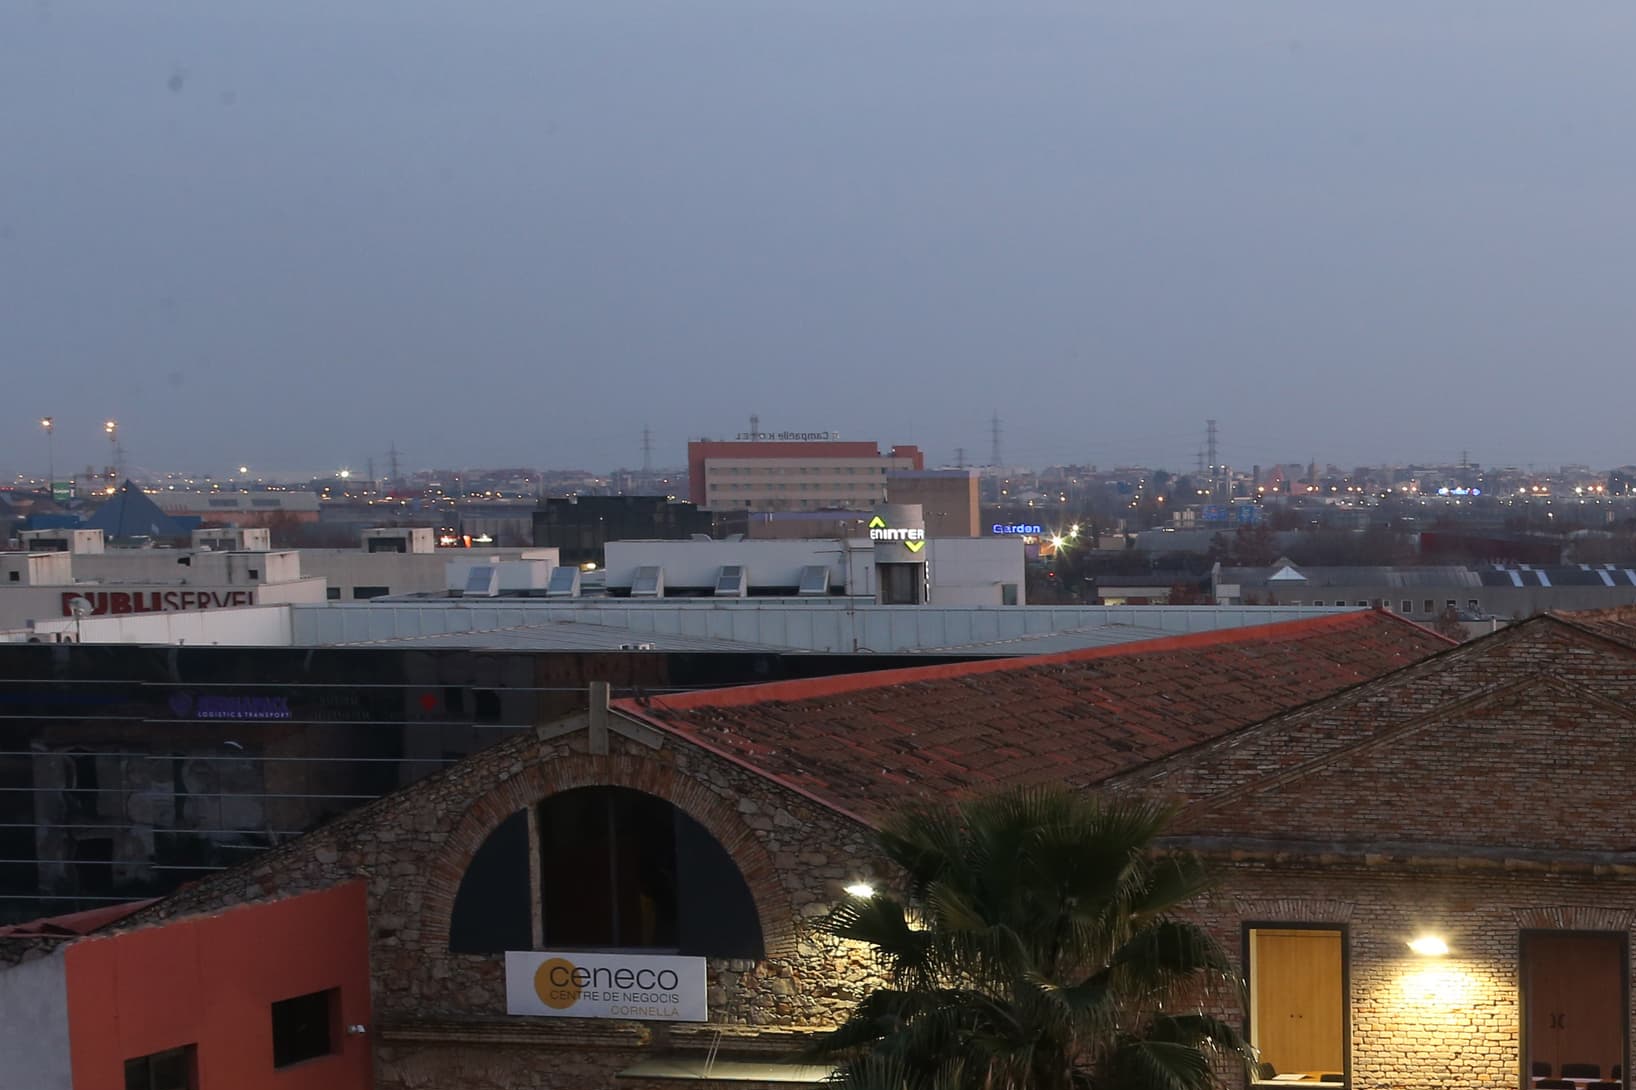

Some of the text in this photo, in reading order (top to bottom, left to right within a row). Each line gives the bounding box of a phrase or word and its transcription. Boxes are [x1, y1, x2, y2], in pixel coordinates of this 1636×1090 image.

[992, 524, 1041, 534] Garden
[244, 711, 290, 719] TRANSPORT
[550, 966, 679, 991] ceneco
[550, 991, 680, 1004] CENTRE DE NEGOCIS
